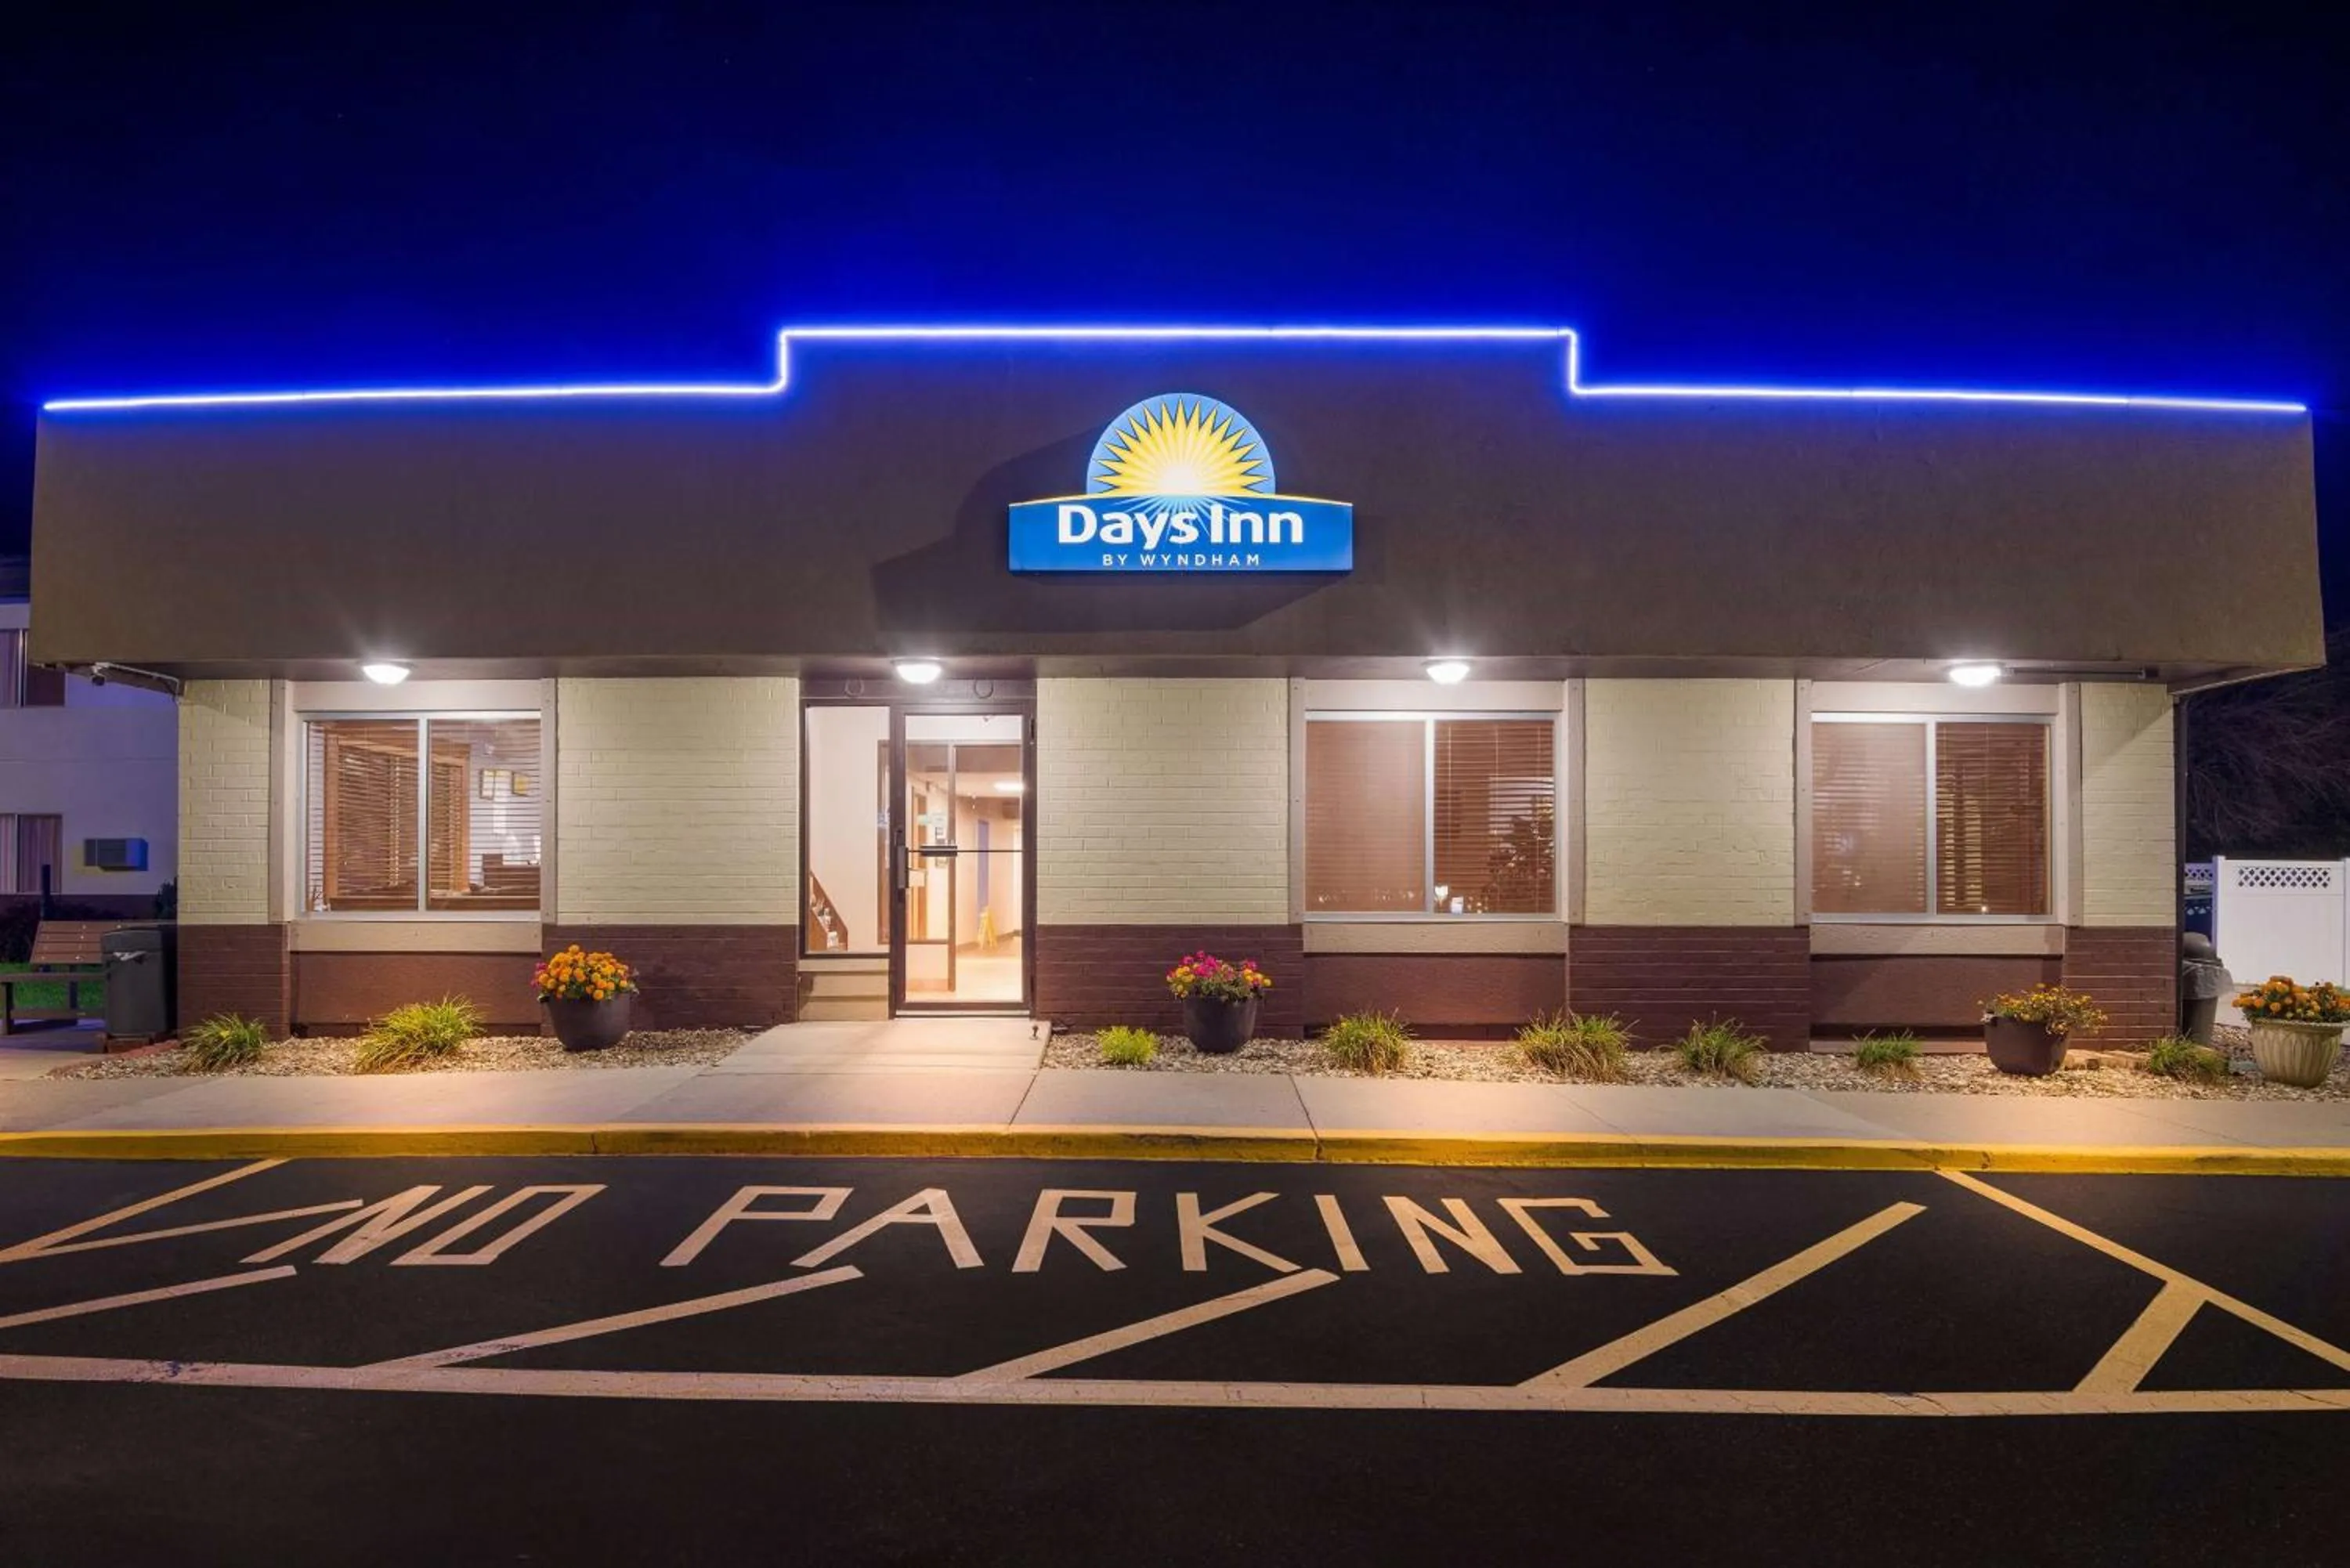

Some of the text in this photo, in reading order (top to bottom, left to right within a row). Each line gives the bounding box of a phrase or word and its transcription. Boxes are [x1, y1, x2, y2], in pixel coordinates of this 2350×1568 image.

[1058, 504, 1303, 550] Days Inn
[1102, 554, 1260, 566] BY WYNDHAM
[239, 1184, 1679, 1277] NO PARKING
